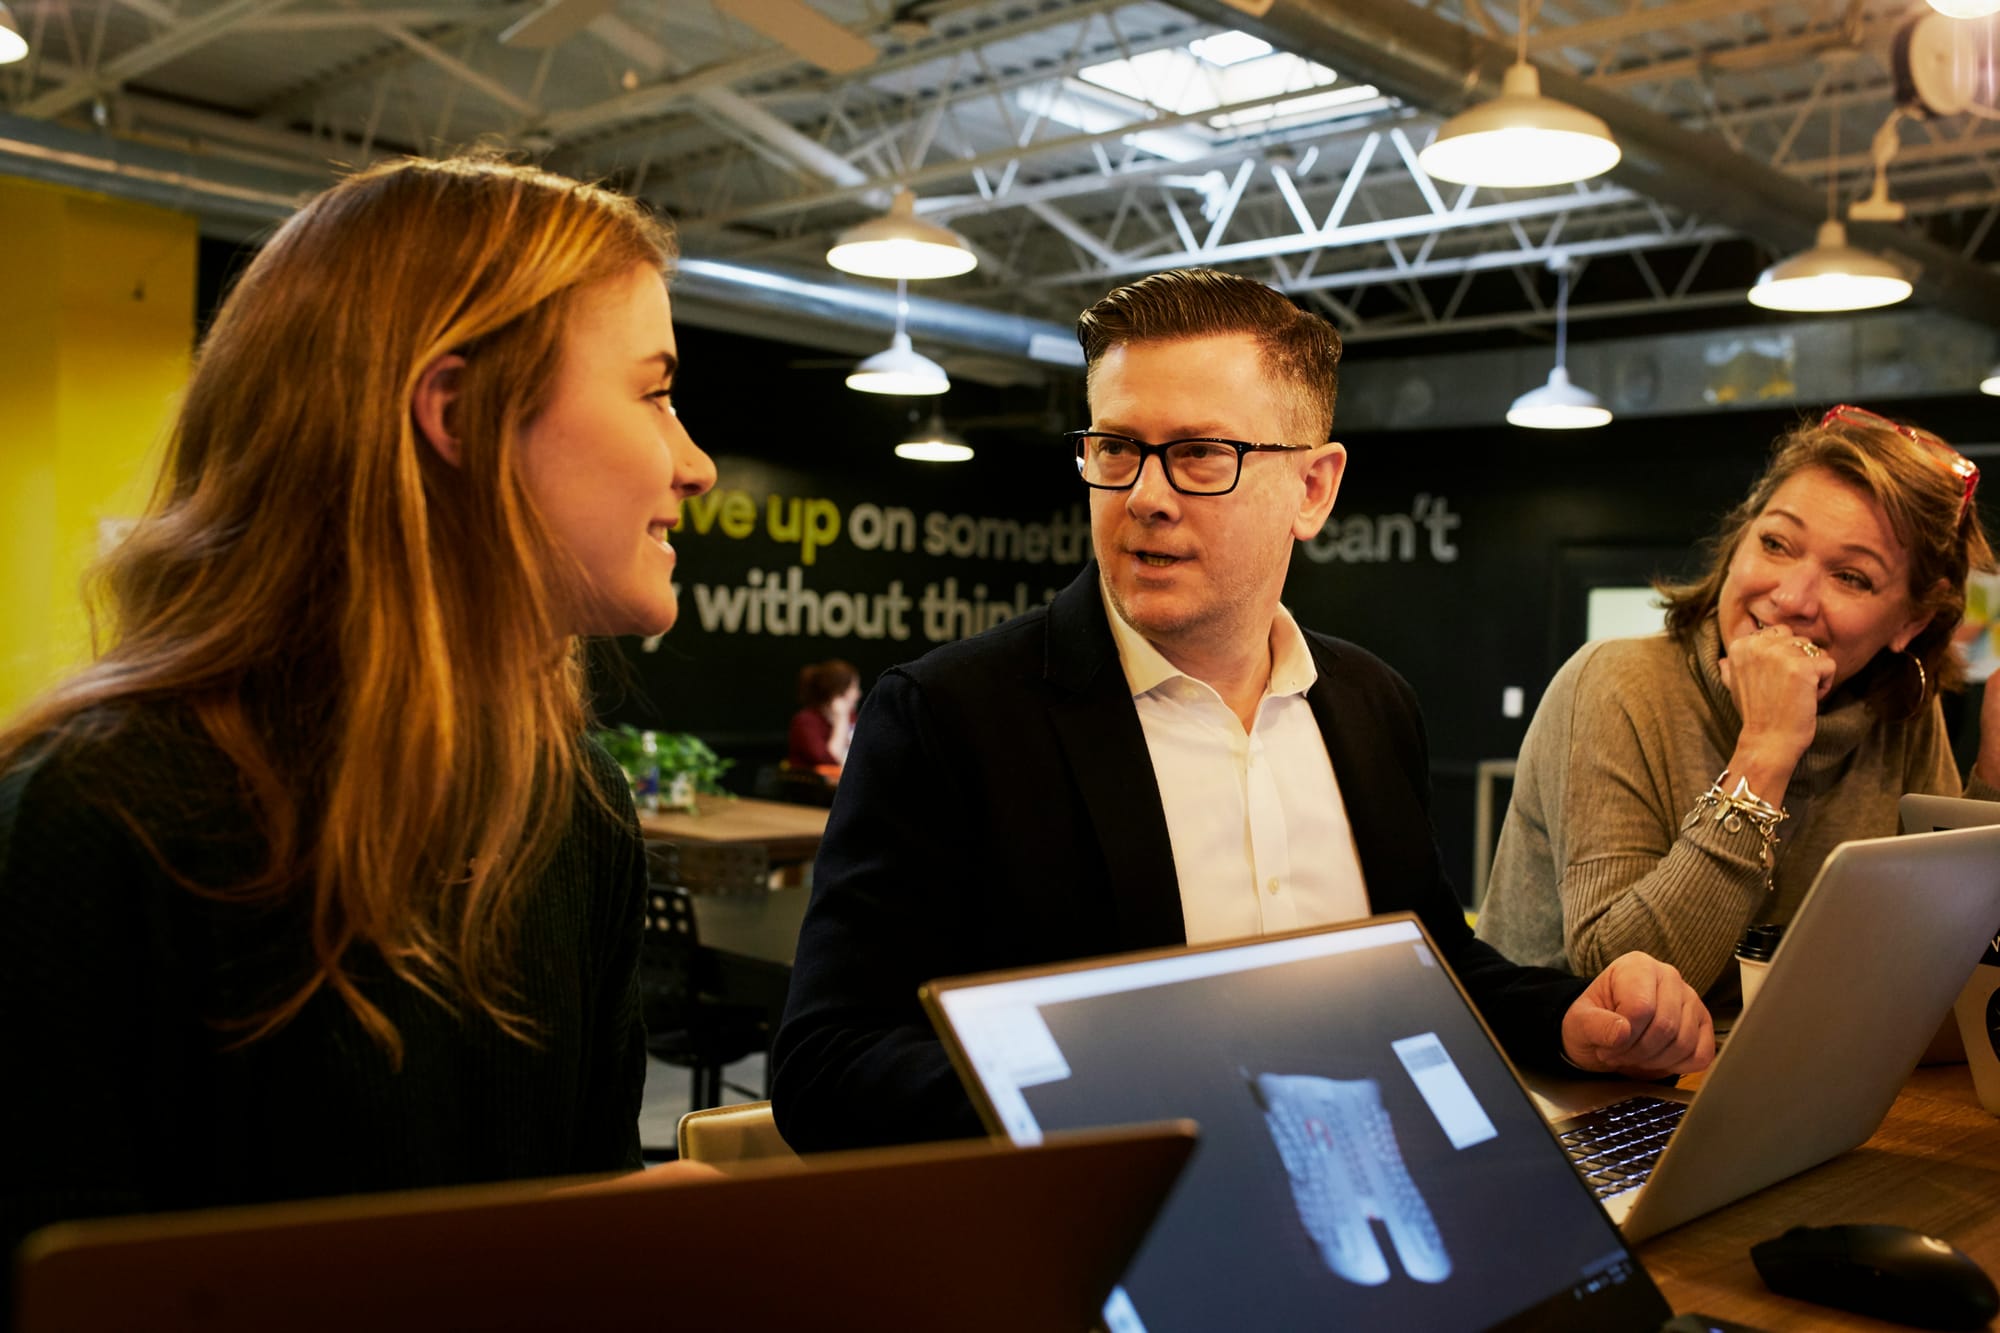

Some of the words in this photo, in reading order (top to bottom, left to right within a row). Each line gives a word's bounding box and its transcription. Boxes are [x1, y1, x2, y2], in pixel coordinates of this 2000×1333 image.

[766, 494, 841, 566] up
[848, 502, 916, 553] on
[1303, 492, 1460, 563] can't
[693, 566, 912, 642] without
